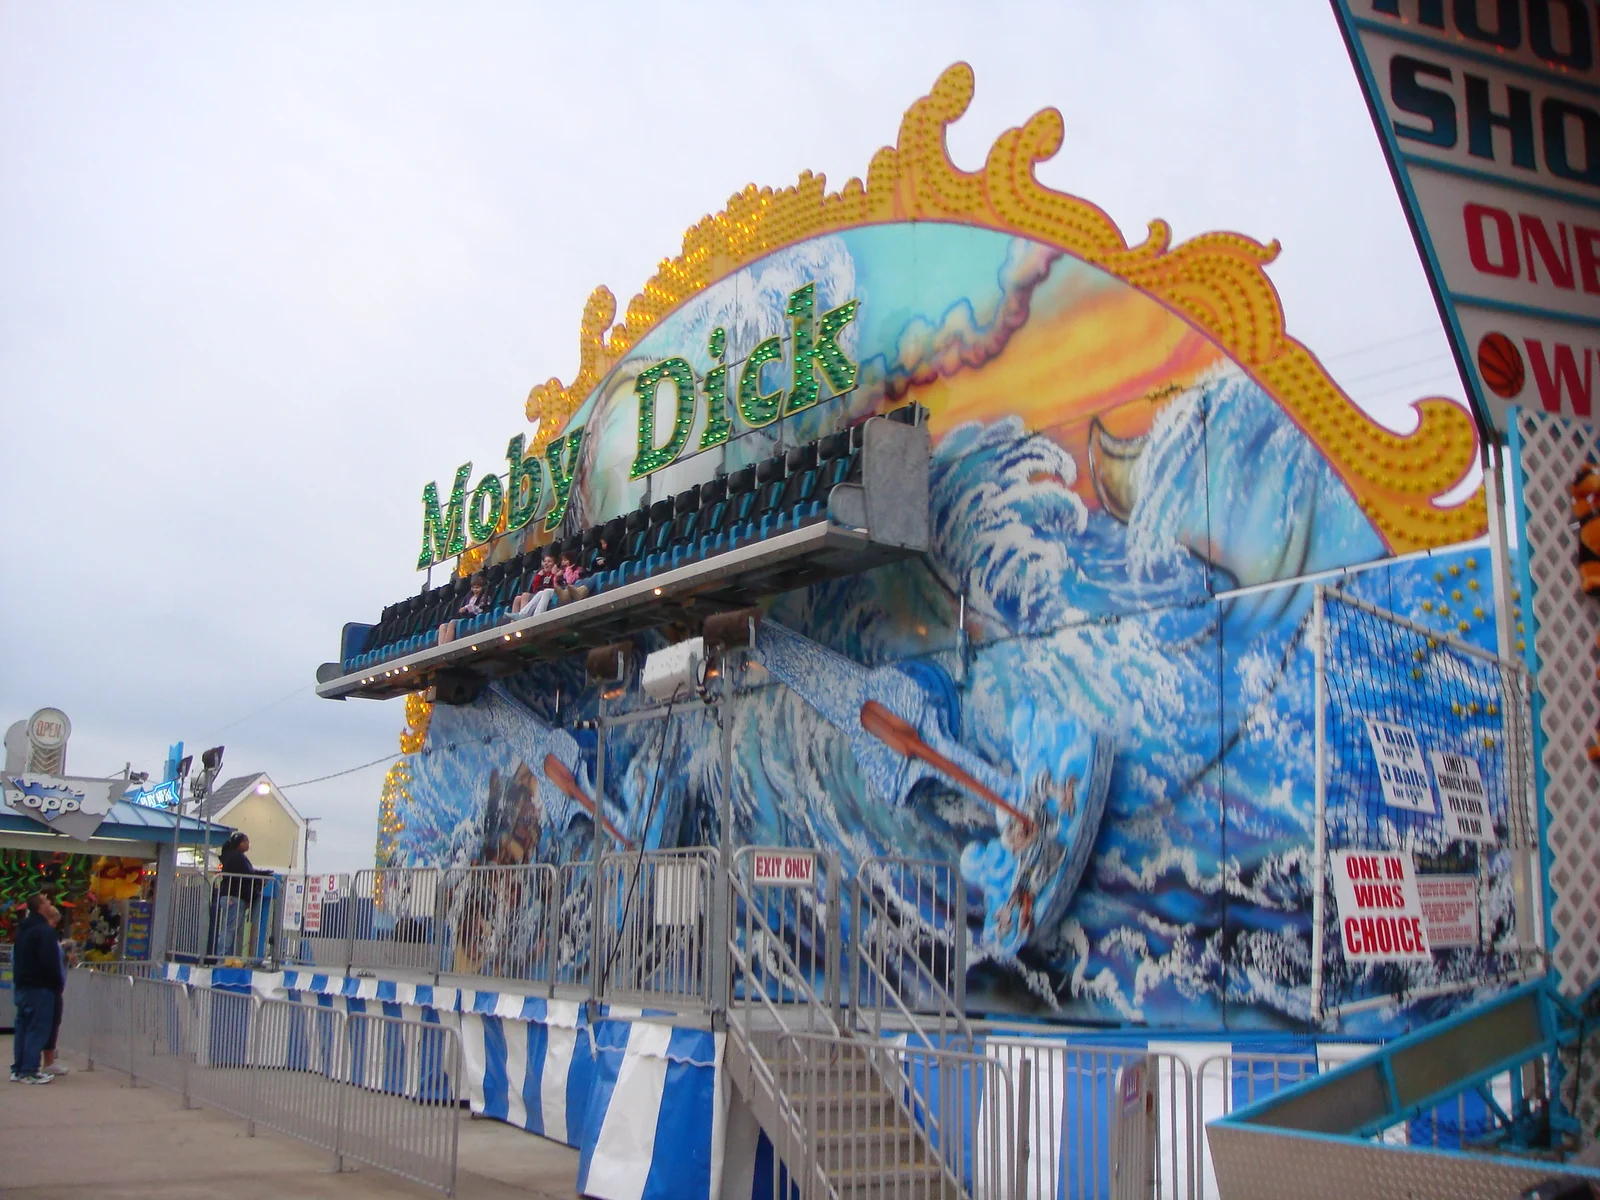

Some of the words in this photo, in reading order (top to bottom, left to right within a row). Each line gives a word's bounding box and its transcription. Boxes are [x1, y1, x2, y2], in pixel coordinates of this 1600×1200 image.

[416, 425, 587, 572] Moby
[628, 281, 860, 482] Dick
[36, 720, 61, 738] OPEN
[1381, 762, 1392, 781] 3
[756, 856, 781, 877] EXIT
[785, 857, 811, 878] ONLY
[1346, 856, 1382, 880] ONE
[1384, 856, 1404, 880] IN
[329, 875, 335, 891] 8
[1353, 884, 1405, 909] WINS
[1344, 917, 1425, 955] CHOICE
